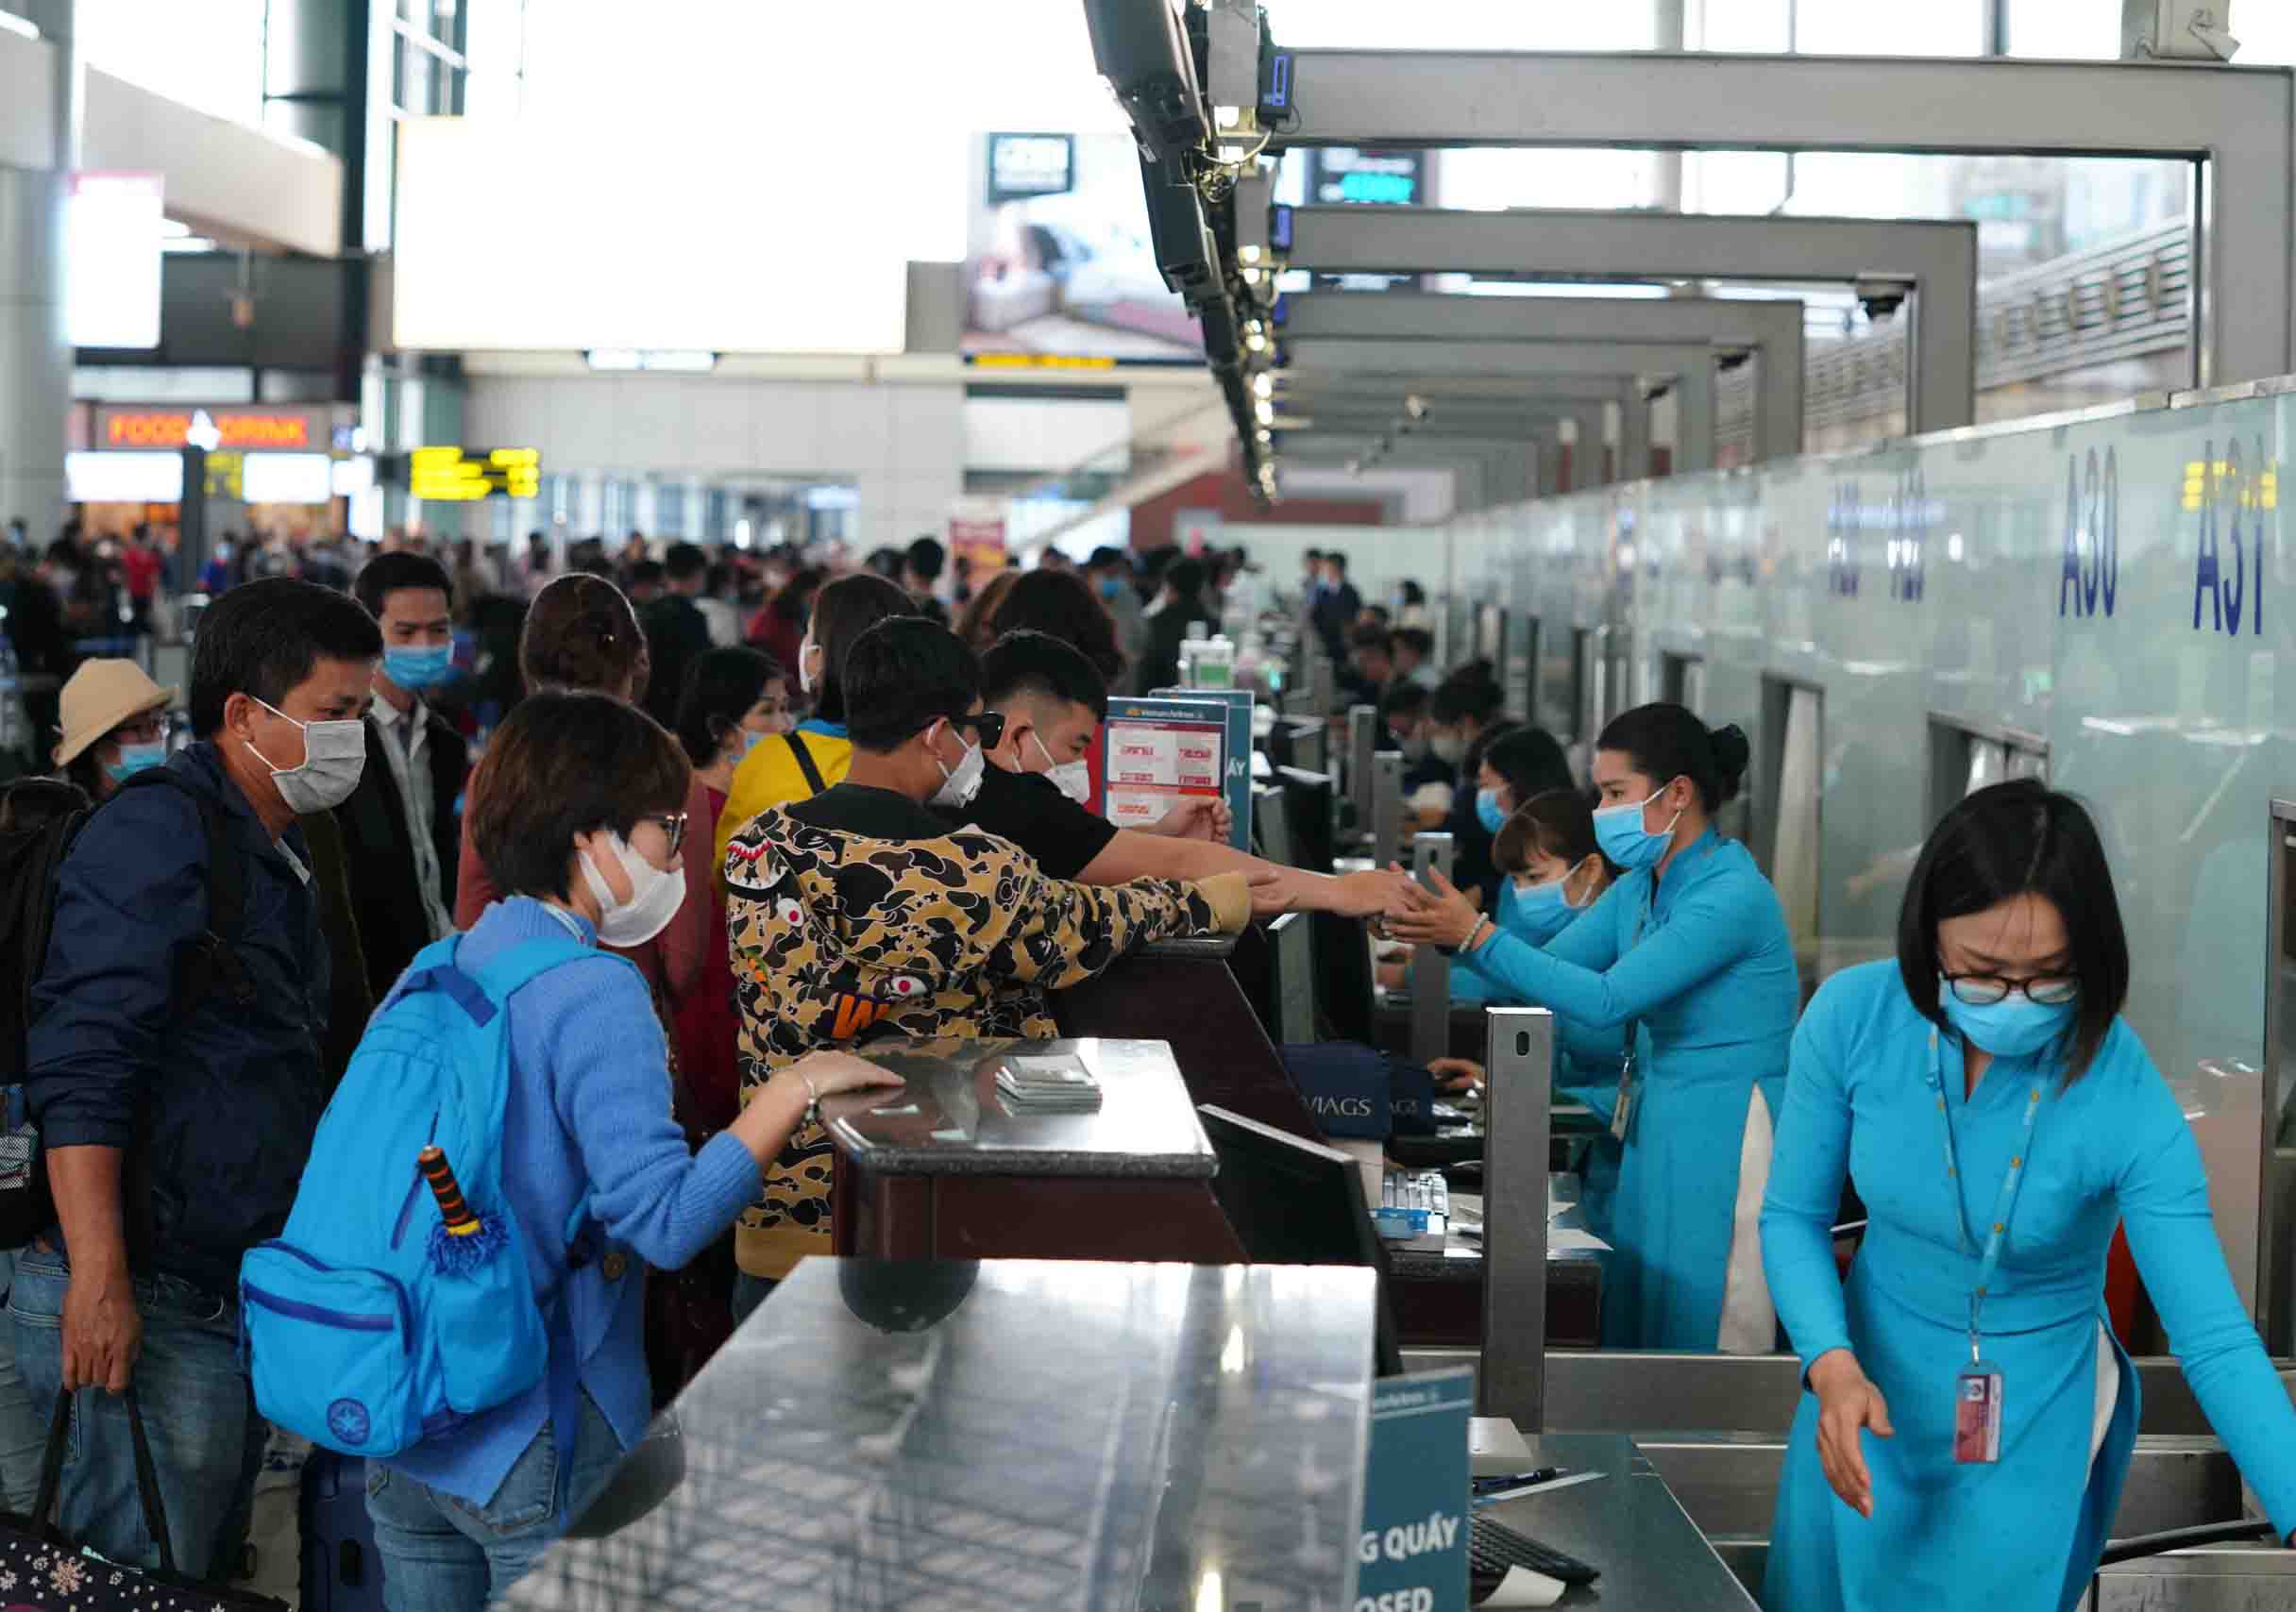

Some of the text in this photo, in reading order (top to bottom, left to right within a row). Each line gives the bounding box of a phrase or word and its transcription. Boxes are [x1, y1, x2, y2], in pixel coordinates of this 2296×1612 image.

[2060, 445, 2118, 618] A30
[2193, 435, 2263, 635] A31
[1301, 1095, 1373, 1117] VIAGS
